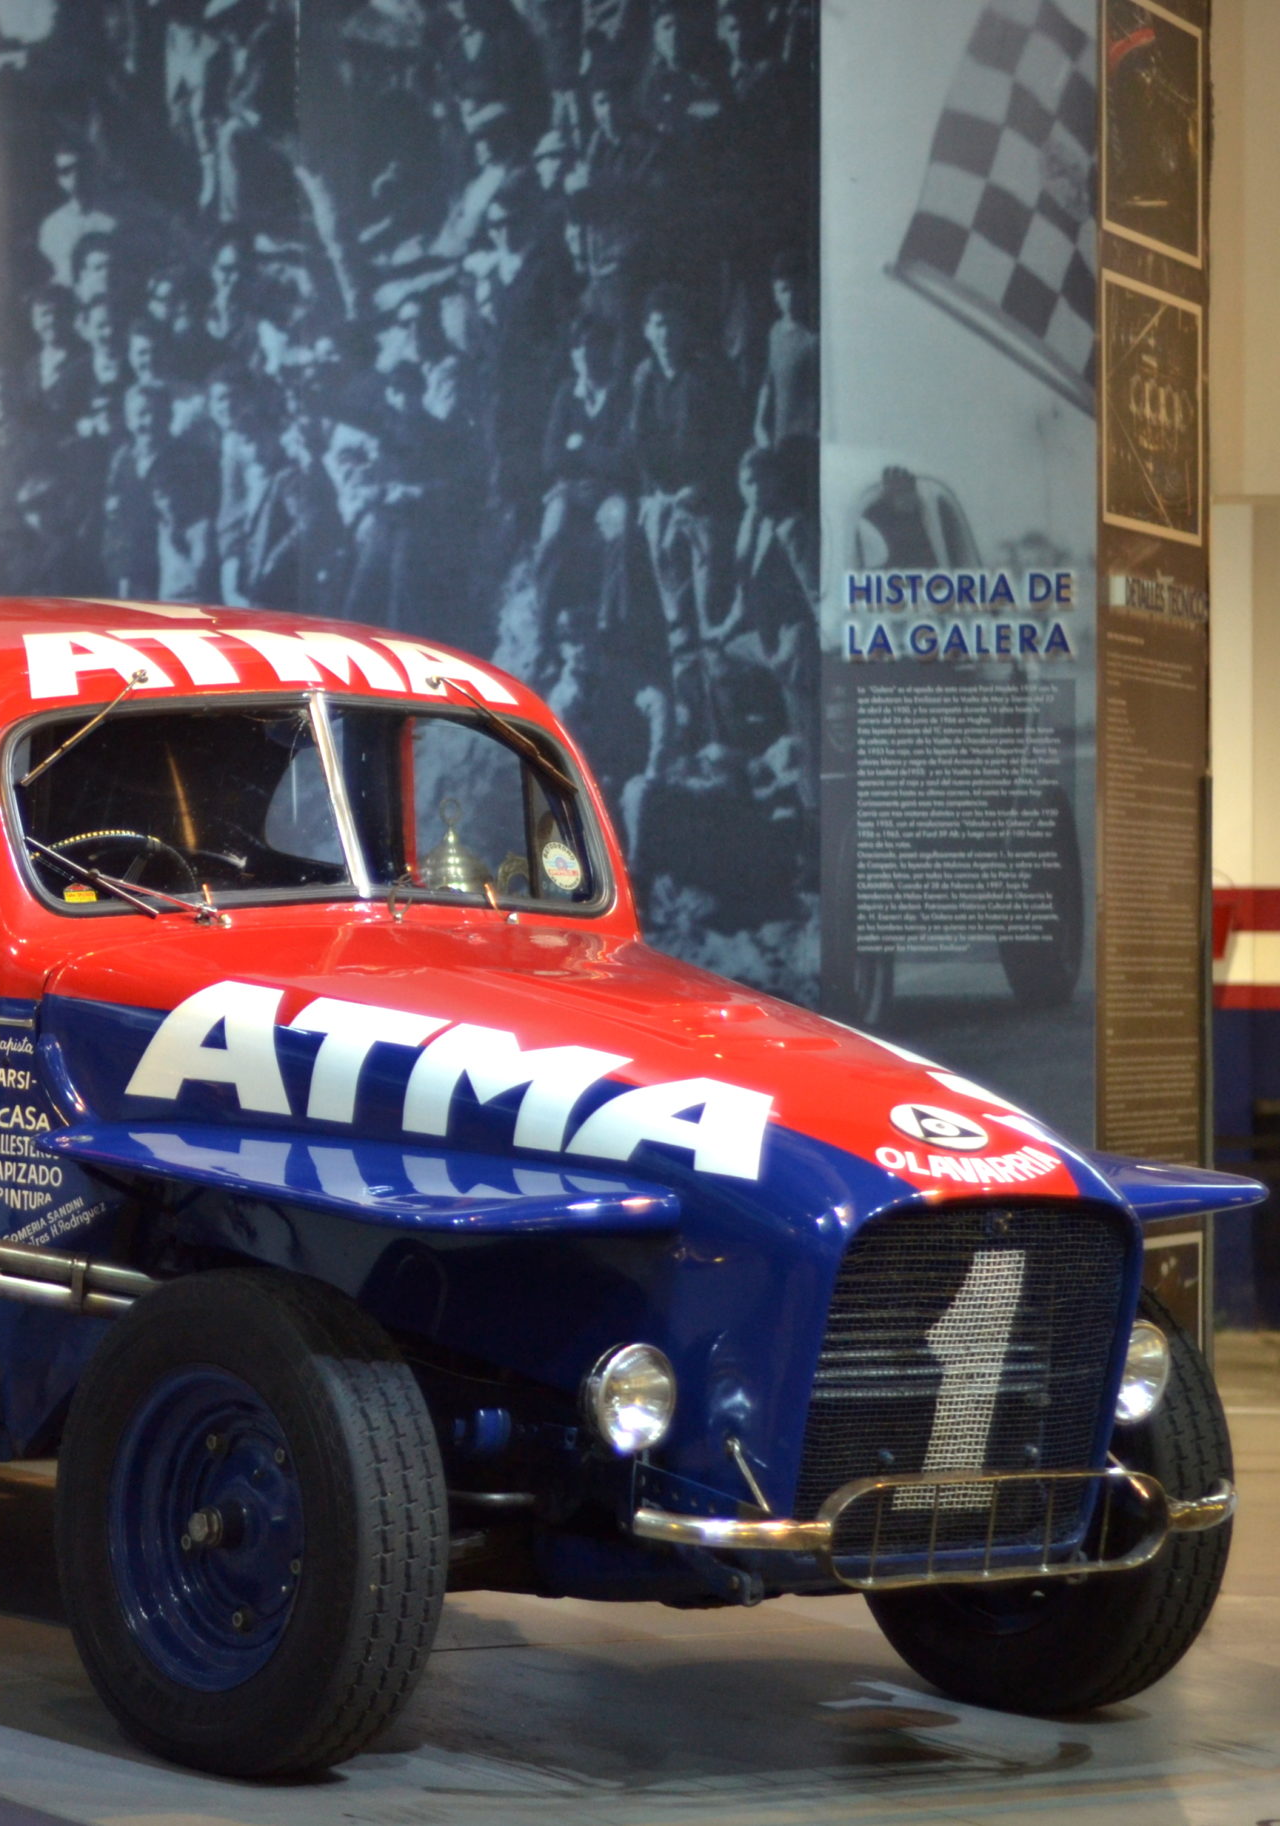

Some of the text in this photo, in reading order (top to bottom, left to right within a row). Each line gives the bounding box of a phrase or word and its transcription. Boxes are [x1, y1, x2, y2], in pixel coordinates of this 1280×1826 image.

[848, 571, 1072, 606] HISTORIA DE
[848, 623, 894, 656] LA
[909, 622, 1072, 656] GALERA
[23, 628, 518, 705] ATMA
[123, 980, 774, 1181] ATMA
[875, 1145, 1062, 1184] OLAVARRIA
[46, 1196, 84, 1224] SANDINI
[892, 1250, 1026, 1512] 1
